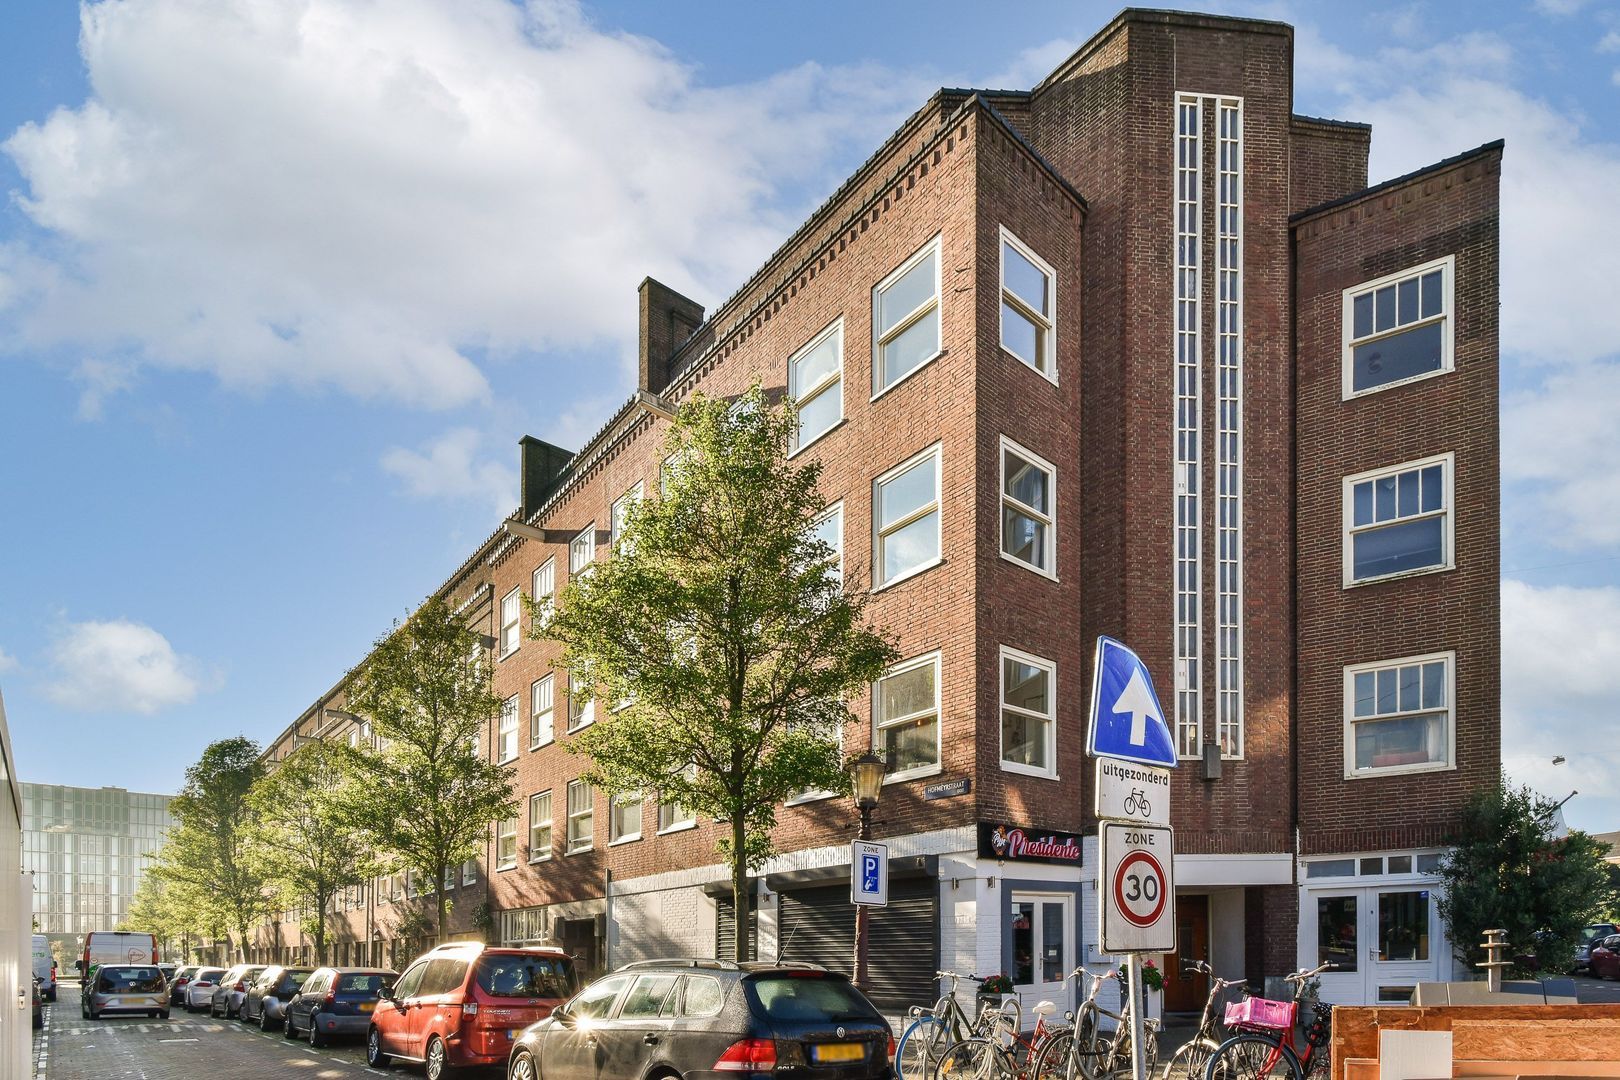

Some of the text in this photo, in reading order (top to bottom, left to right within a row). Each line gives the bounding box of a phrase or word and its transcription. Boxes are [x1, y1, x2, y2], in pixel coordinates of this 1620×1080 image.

[1103, 763, 1168, 786] uitgezonderd
[863, 845, 879, 854] ZONE
[1007, 828, 1081, 860] Presidente
[1124, 832, 1155, 846] ZONE
[865, 857, 876, 877] P
[1125, 874, 1158, 902] 30
